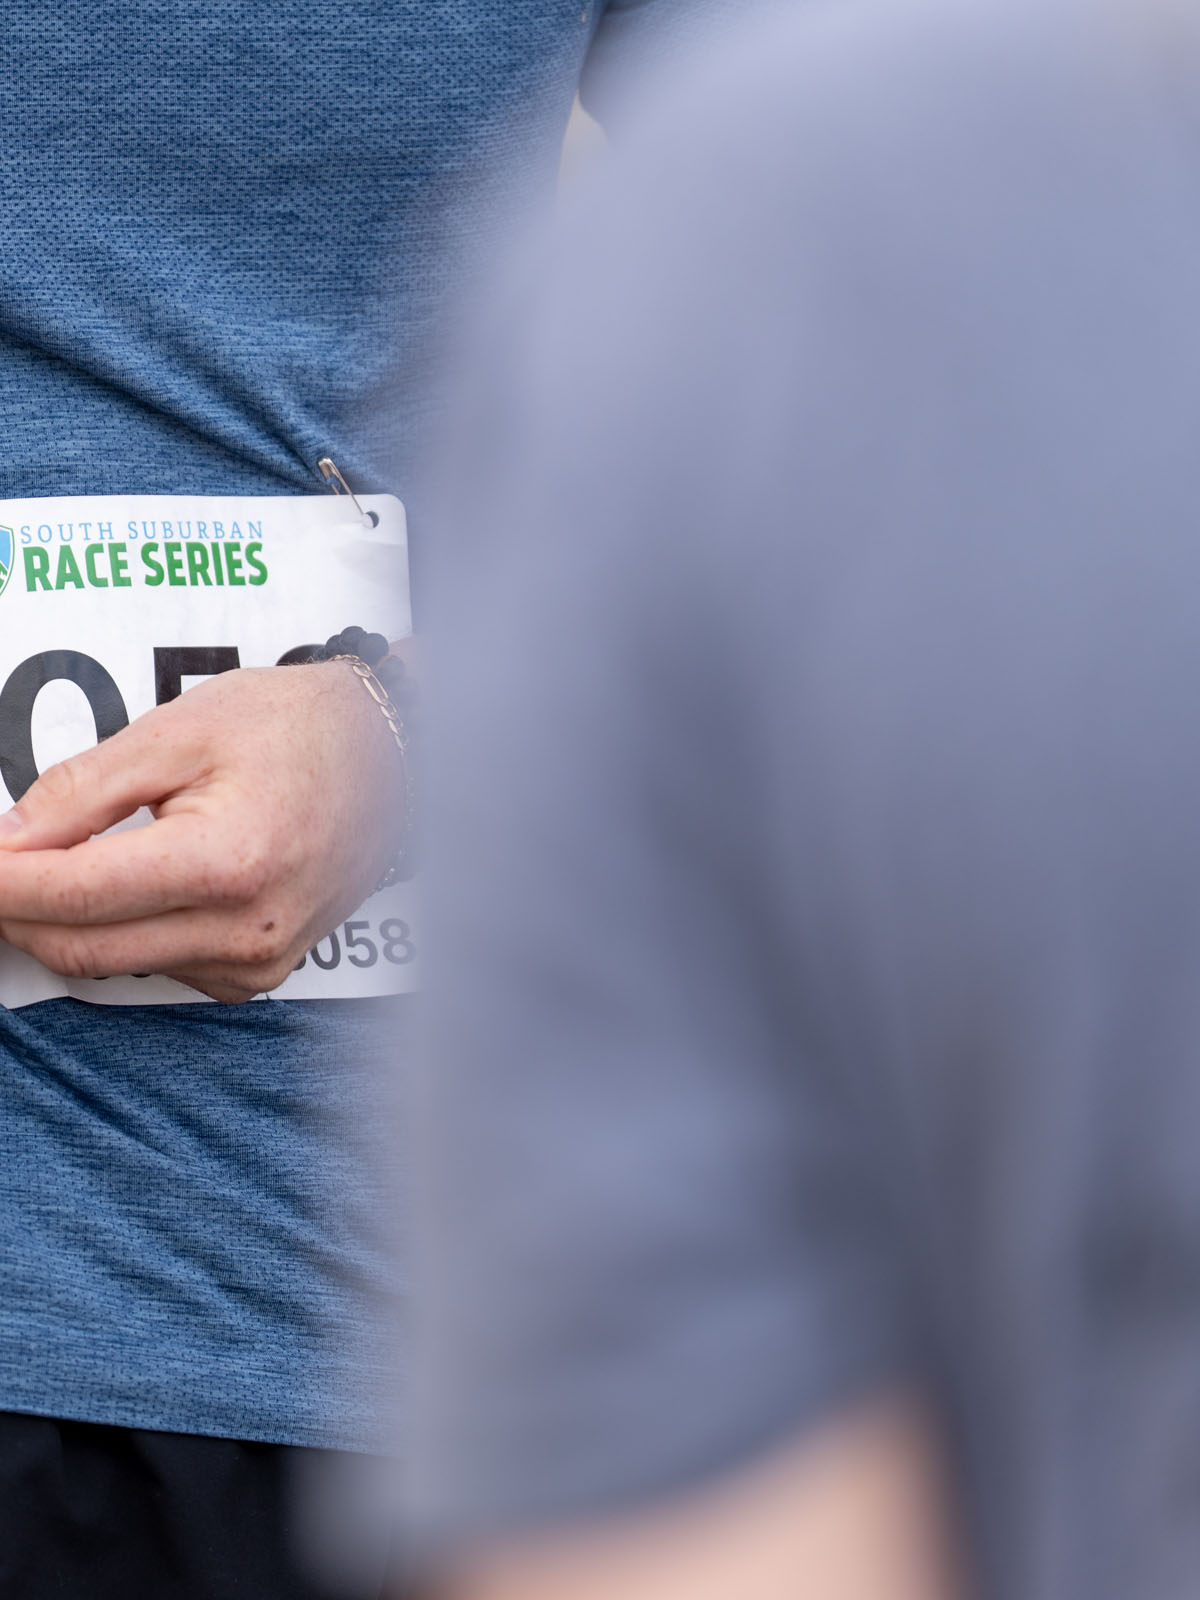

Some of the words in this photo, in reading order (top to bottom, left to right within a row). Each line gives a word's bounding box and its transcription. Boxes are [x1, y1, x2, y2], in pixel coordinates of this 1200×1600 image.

[20, 521, 114, 544] SOUTH
[128, 520, 264, 541] SUBURBAN
[23, 542, 132, 592] RACE
[141, 541, 269, 586] SERIES
[292, 918, 416, 971] 058
